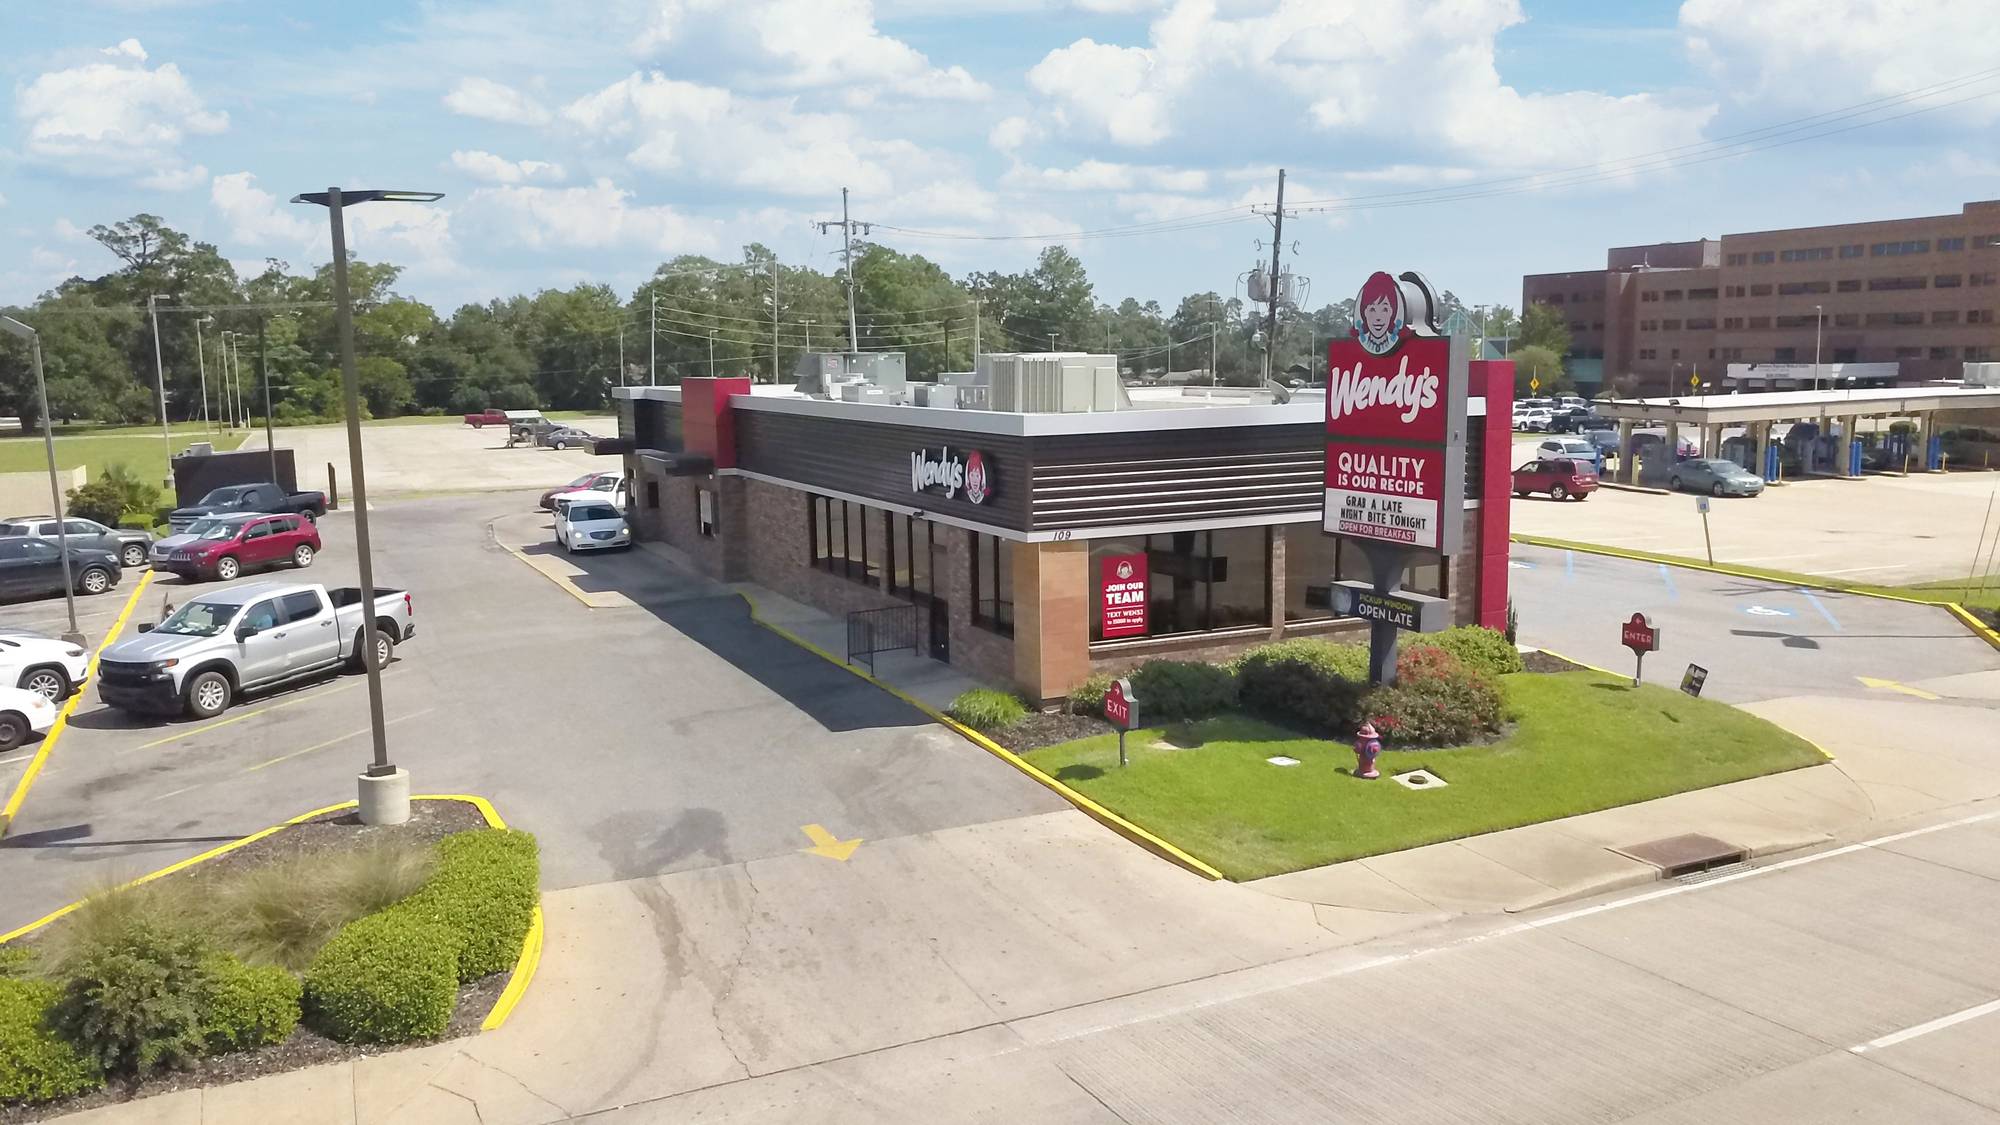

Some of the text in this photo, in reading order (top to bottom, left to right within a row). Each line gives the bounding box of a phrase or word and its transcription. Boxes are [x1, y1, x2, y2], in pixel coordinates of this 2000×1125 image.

[1331, 355, 1439, 424] Wendy's
[911, 445, 963, 499] Wendy's
[1338, 451, 1425, 479] QUALITY
[1338, 473, 1424, 495] IS OUR RECIPE
[1346, 495, 1402, 513] GRAB A LATE
[1340, 508, 1426, 529] NIGHT BITE TONIGHT
[1053, 530, 1071, 541] 109
[1340, 521, 1415, 541] OPEN FOR BREAKFAST
[1105, 582, 1144, 592] JOIN OUR
[1105, 591, 1144, 605] TEAM
[1358, 603, 1413, 627] OPEN LATE
[1624, 630, 1652, 644] ENTER
[1107, 699, 1128, 719] EXIT
